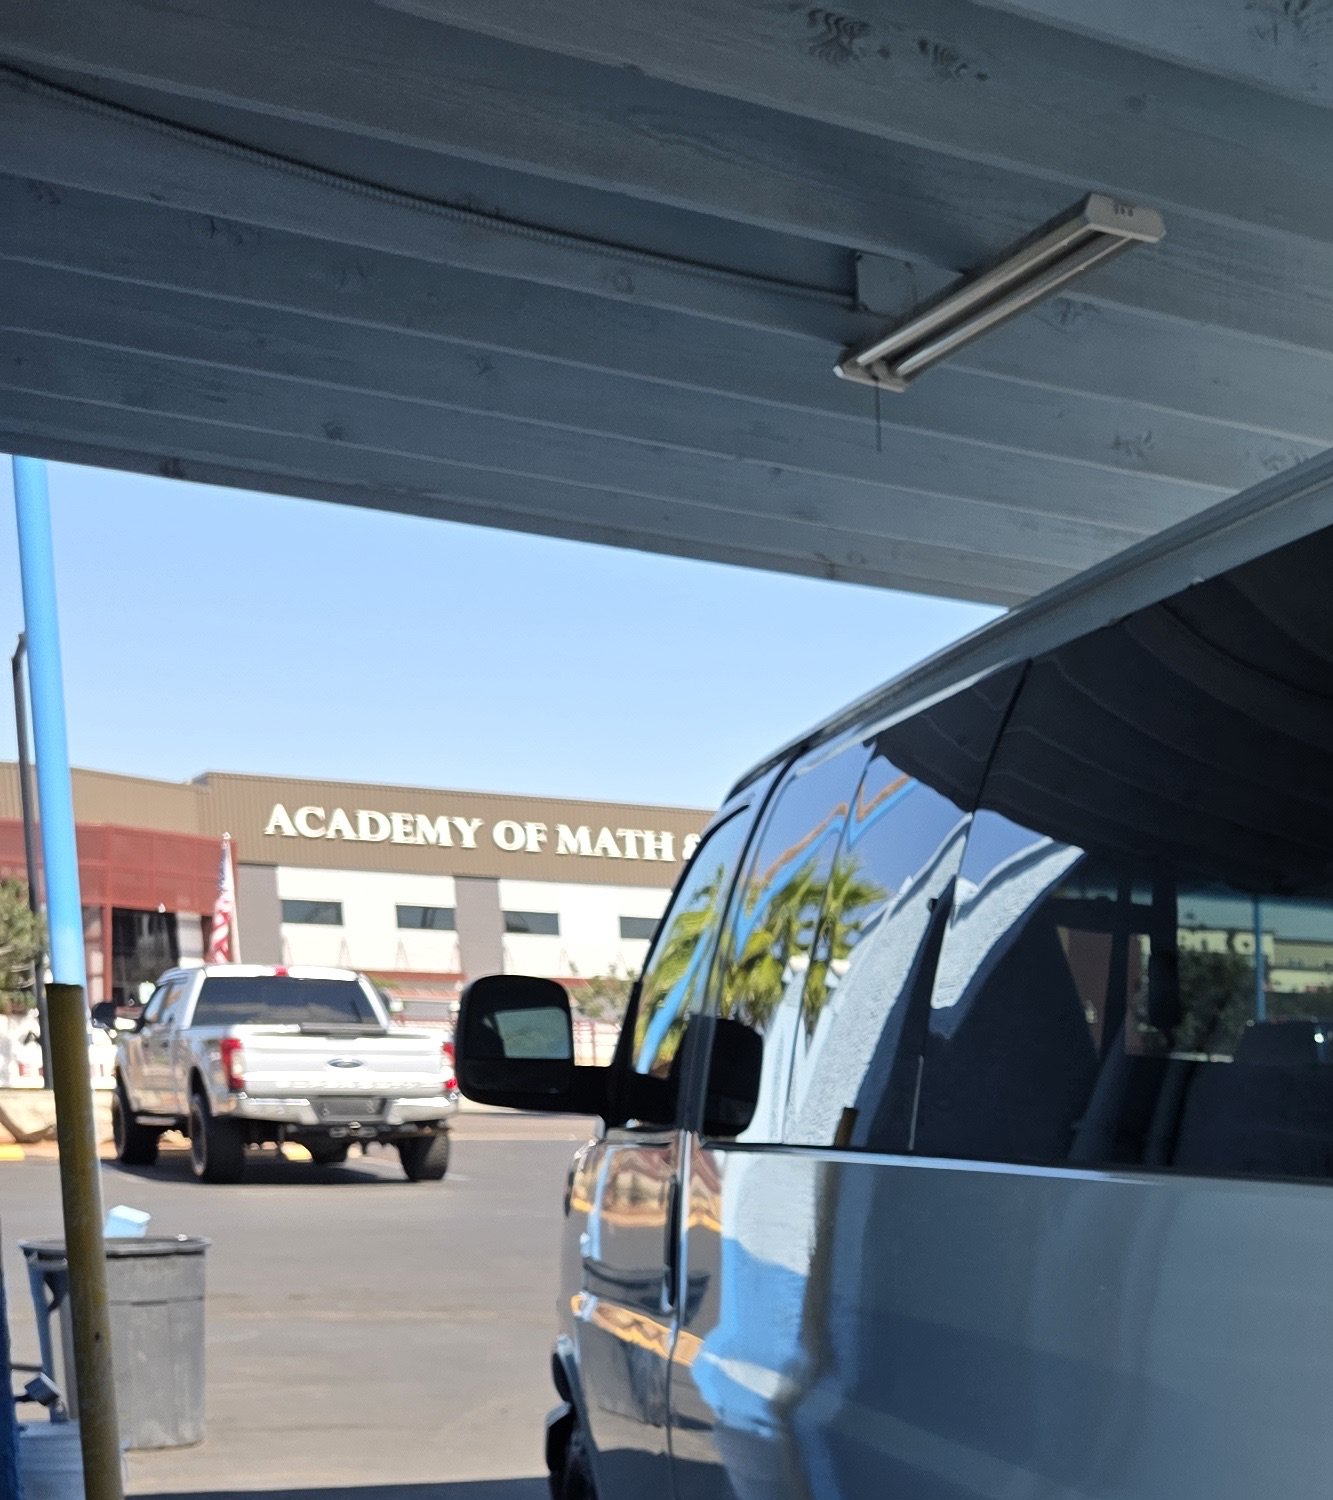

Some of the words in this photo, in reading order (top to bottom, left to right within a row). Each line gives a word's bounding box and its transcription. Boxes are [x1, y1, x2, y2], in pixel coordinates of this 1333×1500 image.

[264, 803, 484, 849] ACADEMY
[492, 820, 548, 852] OF
[555, 823, 676, 861] MATH
